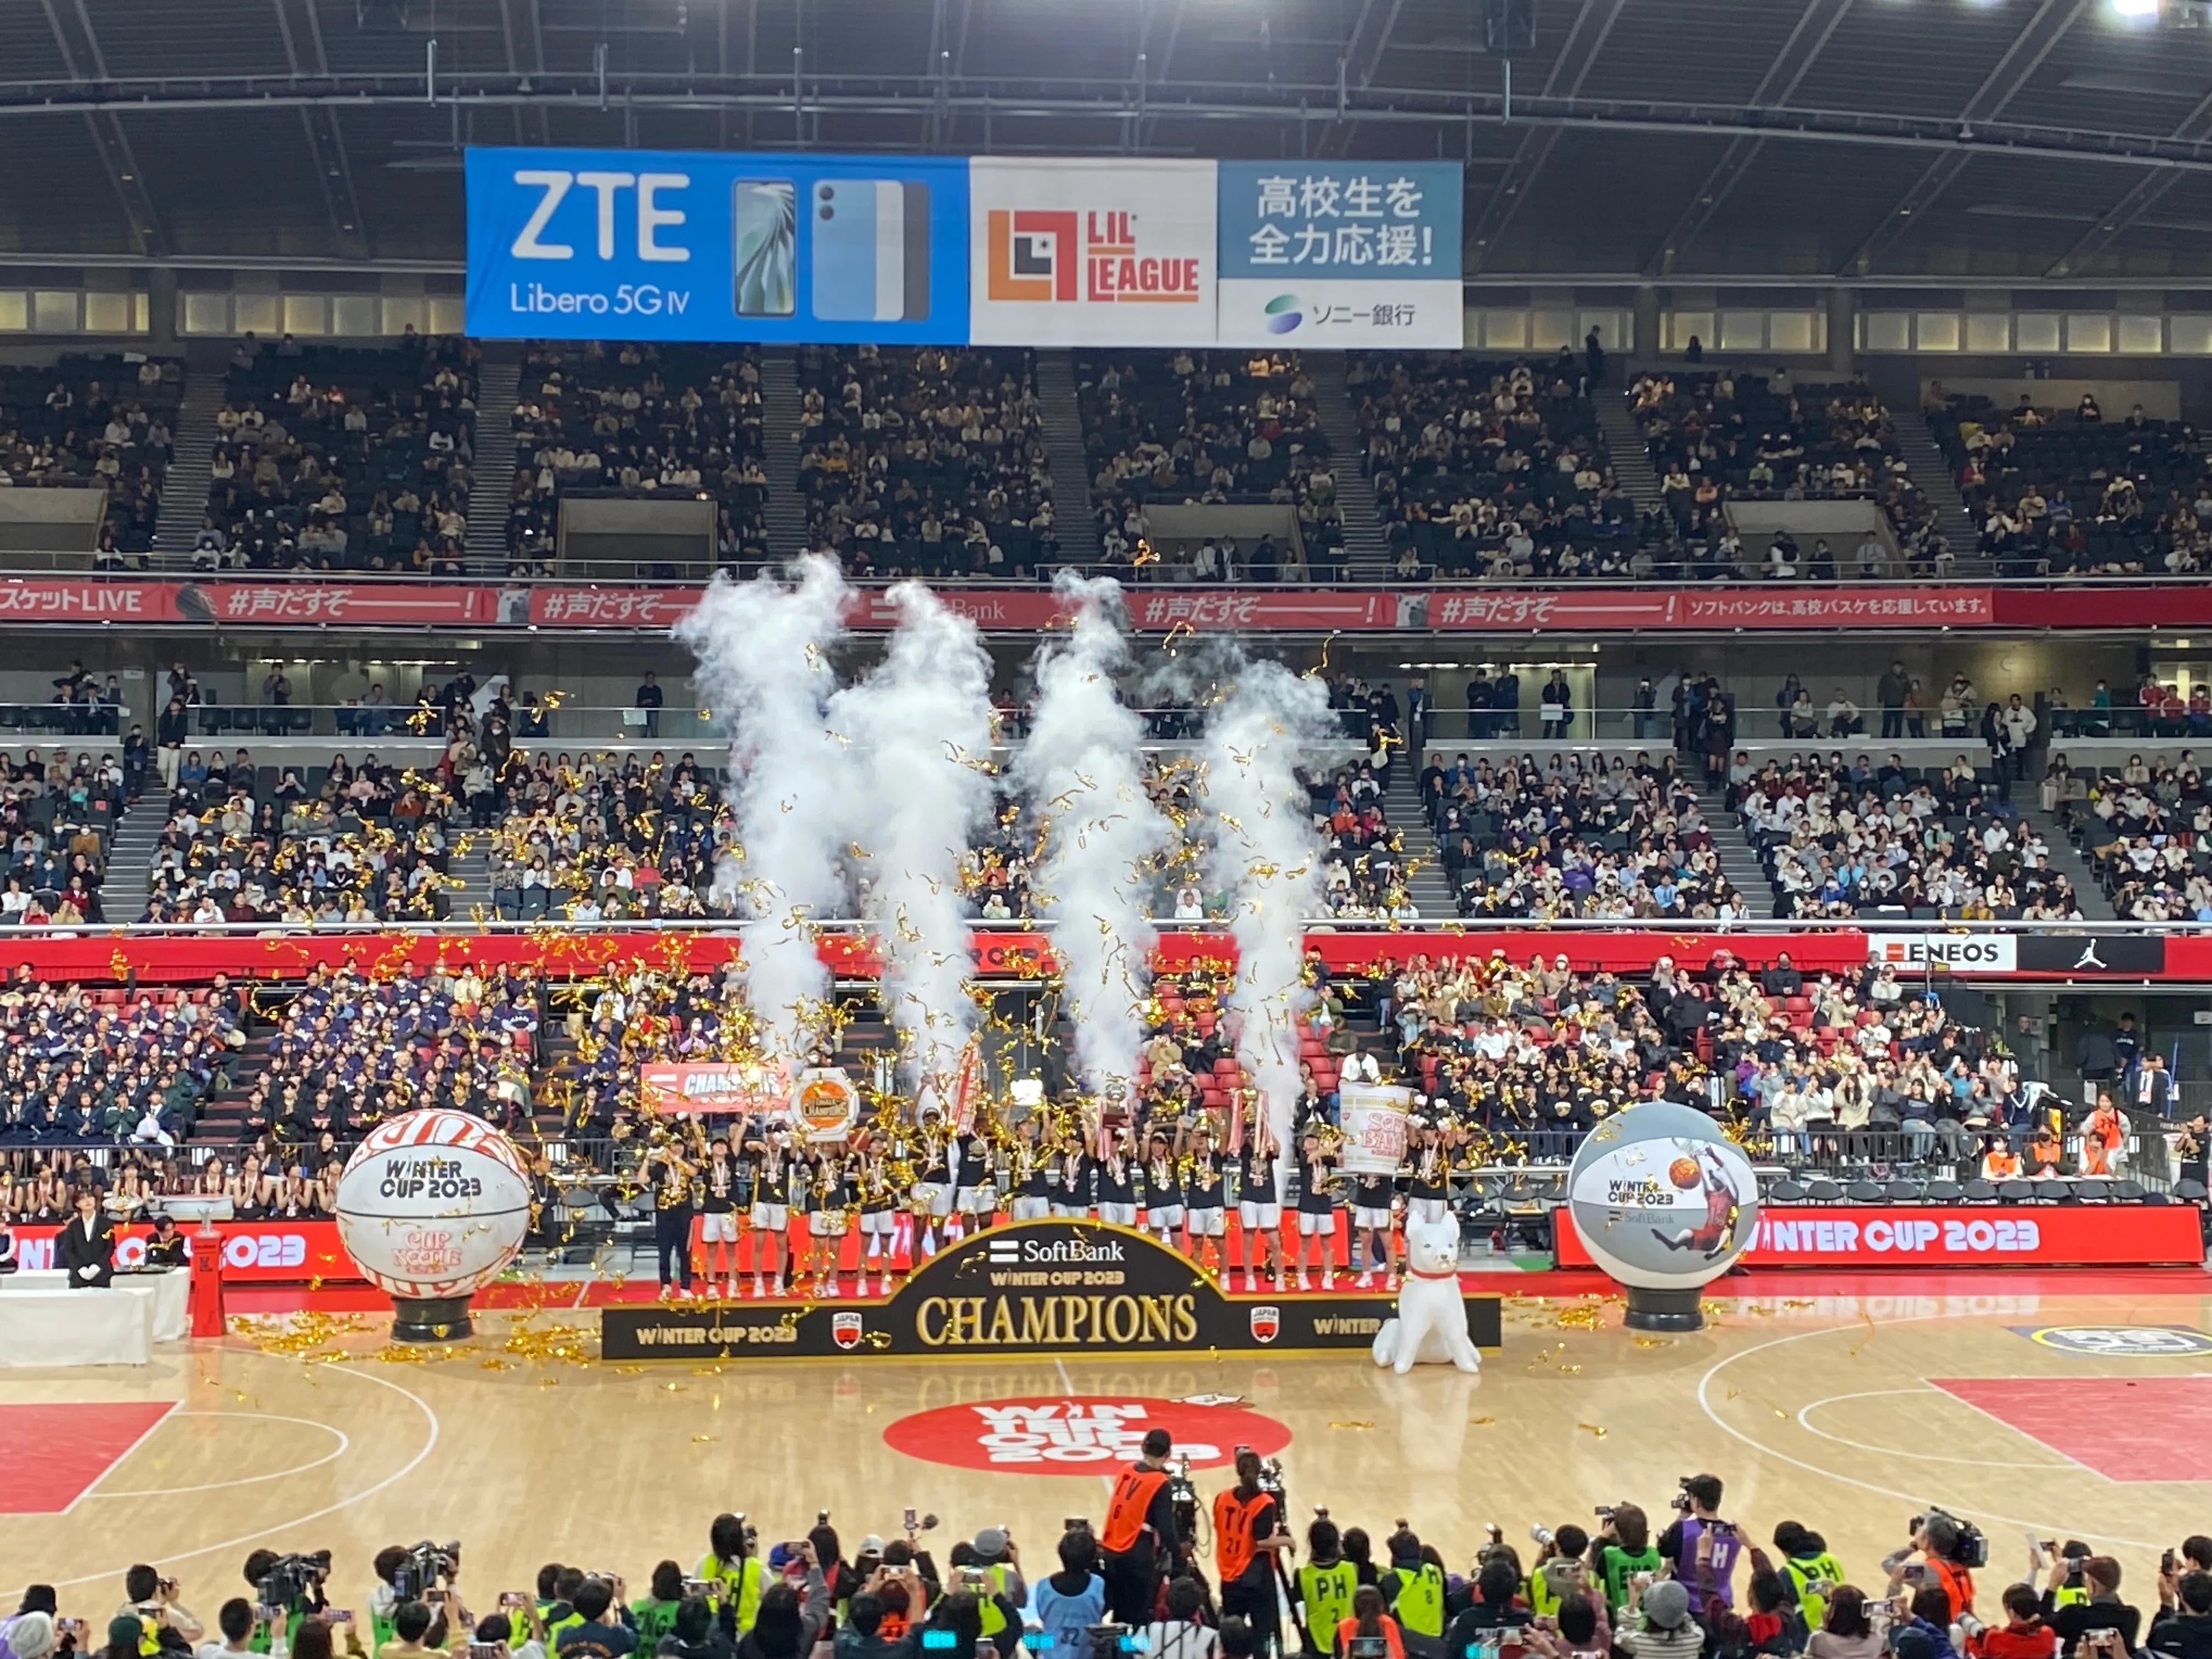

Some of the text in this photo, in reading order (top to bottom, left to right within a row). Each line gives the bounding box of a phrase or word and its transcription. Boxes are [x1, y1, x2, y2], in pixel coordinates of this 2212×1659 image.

[1257, 176, 1423, 218] 高校生を
[511, 171, 690, 261] ZTE
[1088, 211, 1135, 243] LIL
[1249, 224, 1432, 266] 全力応援!
[1088, 258, 1199, 301] LEAGUE
[510, 283, 690, 314] Libero 5G IV
[1313, 303, 1416, 326] ソニー銀行
[1909, 943, 1999, 962] ENEOS
[386, 1158, 462, 1179] WINTER
[380, 1178, 482, 1198] CUP 2023
[1637, 1193, 1673, 1205] 2023
[1624, 1211, 1674, 1224] SoftBank
[405, 1231, 451, 1250] CUP
[1864, 1220, 1939, 1252] CUP
[1945, 1220, 2040, 1252] 2023
[1024, 1240, 1125, 1261] SoftBank
[991, 1271, 1125, 1286] WINTER CUP 2023
[916, 1295, 1197, 1346] CHAMPIONS
[1313, 1317, 1380, 1335] WINTER
[636, 1324, 705, 1345] WINTER
[708, 1328, 746, 1344] CUP
[1116, 1474, 1142, 1500] TV
[1225, 1506, 1247, 1535] TV
[1315, 1573, 1347, 1602] PH
